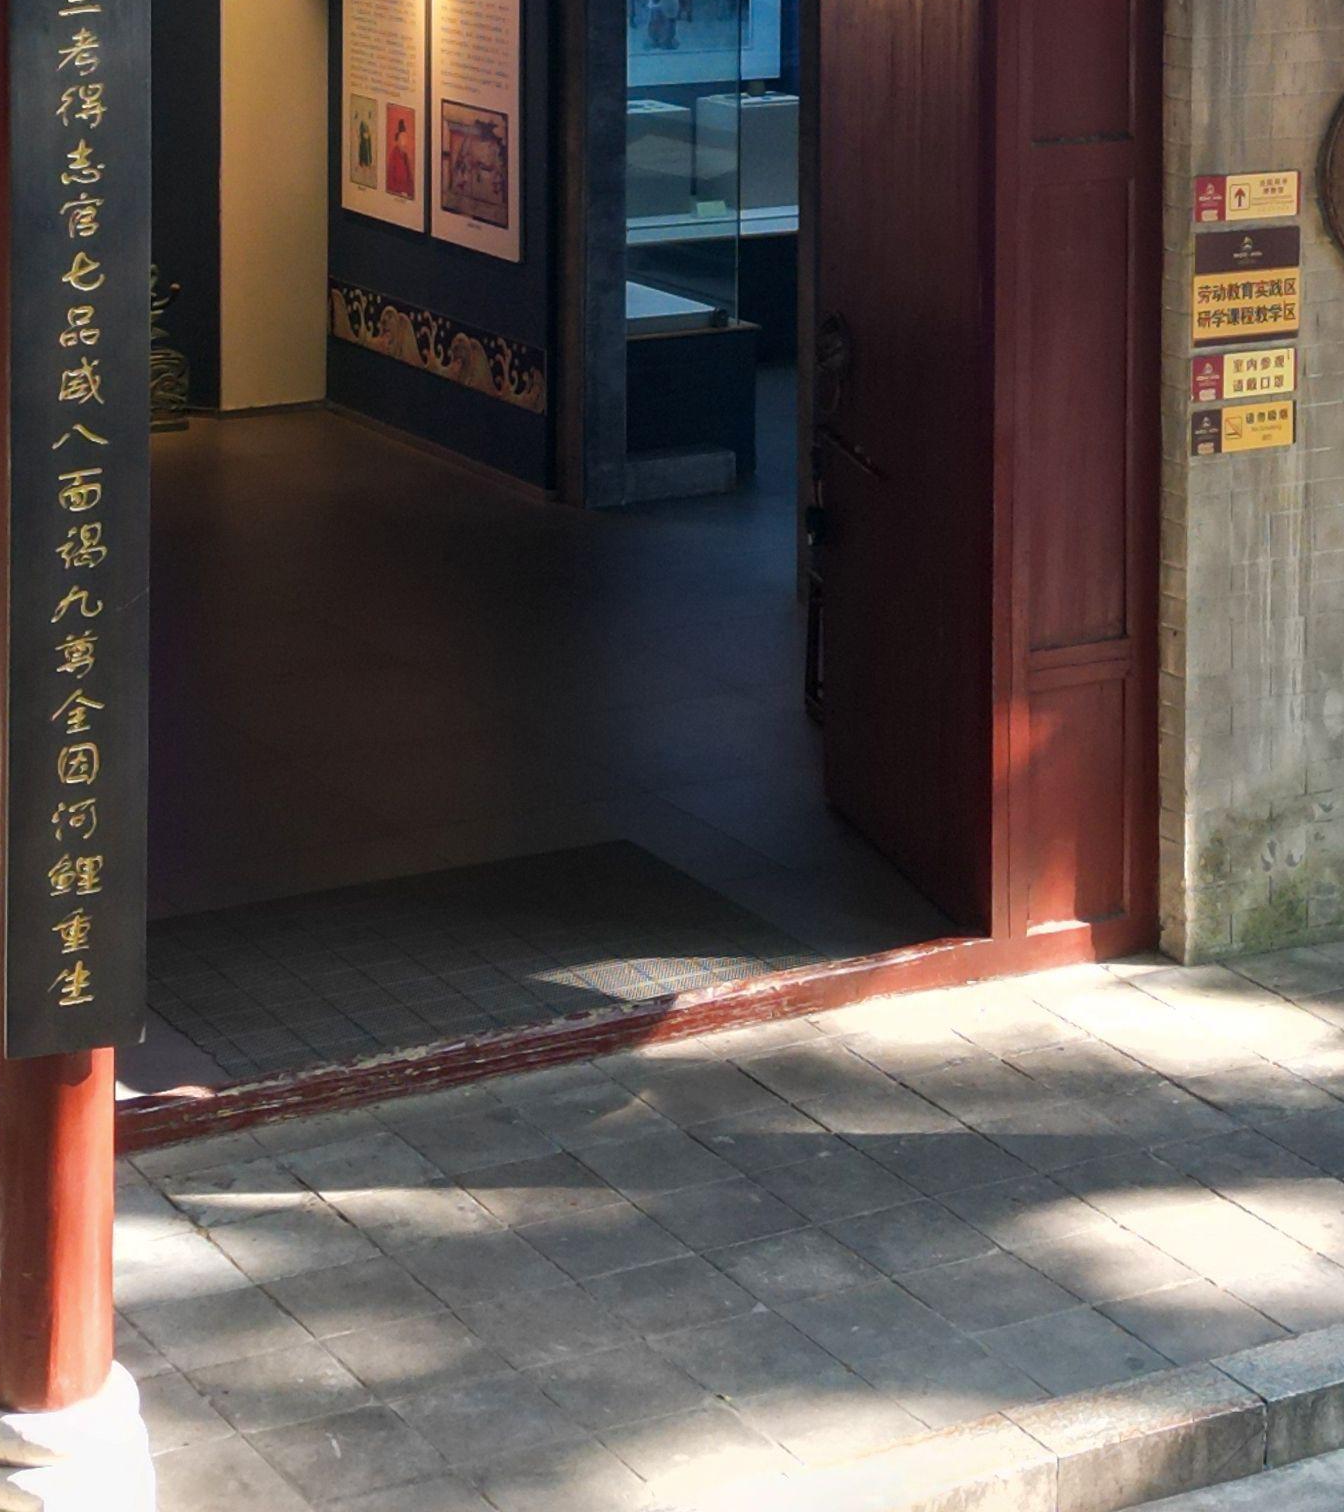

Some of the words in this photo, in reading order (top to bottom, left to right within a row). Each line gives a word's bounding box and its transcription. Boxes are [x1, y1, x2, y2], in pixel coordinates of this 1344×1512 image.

[1197, 277, 1296, 305] 劳动教育实践区
[1197, 301, 1296, 328] 研学课程教学区
